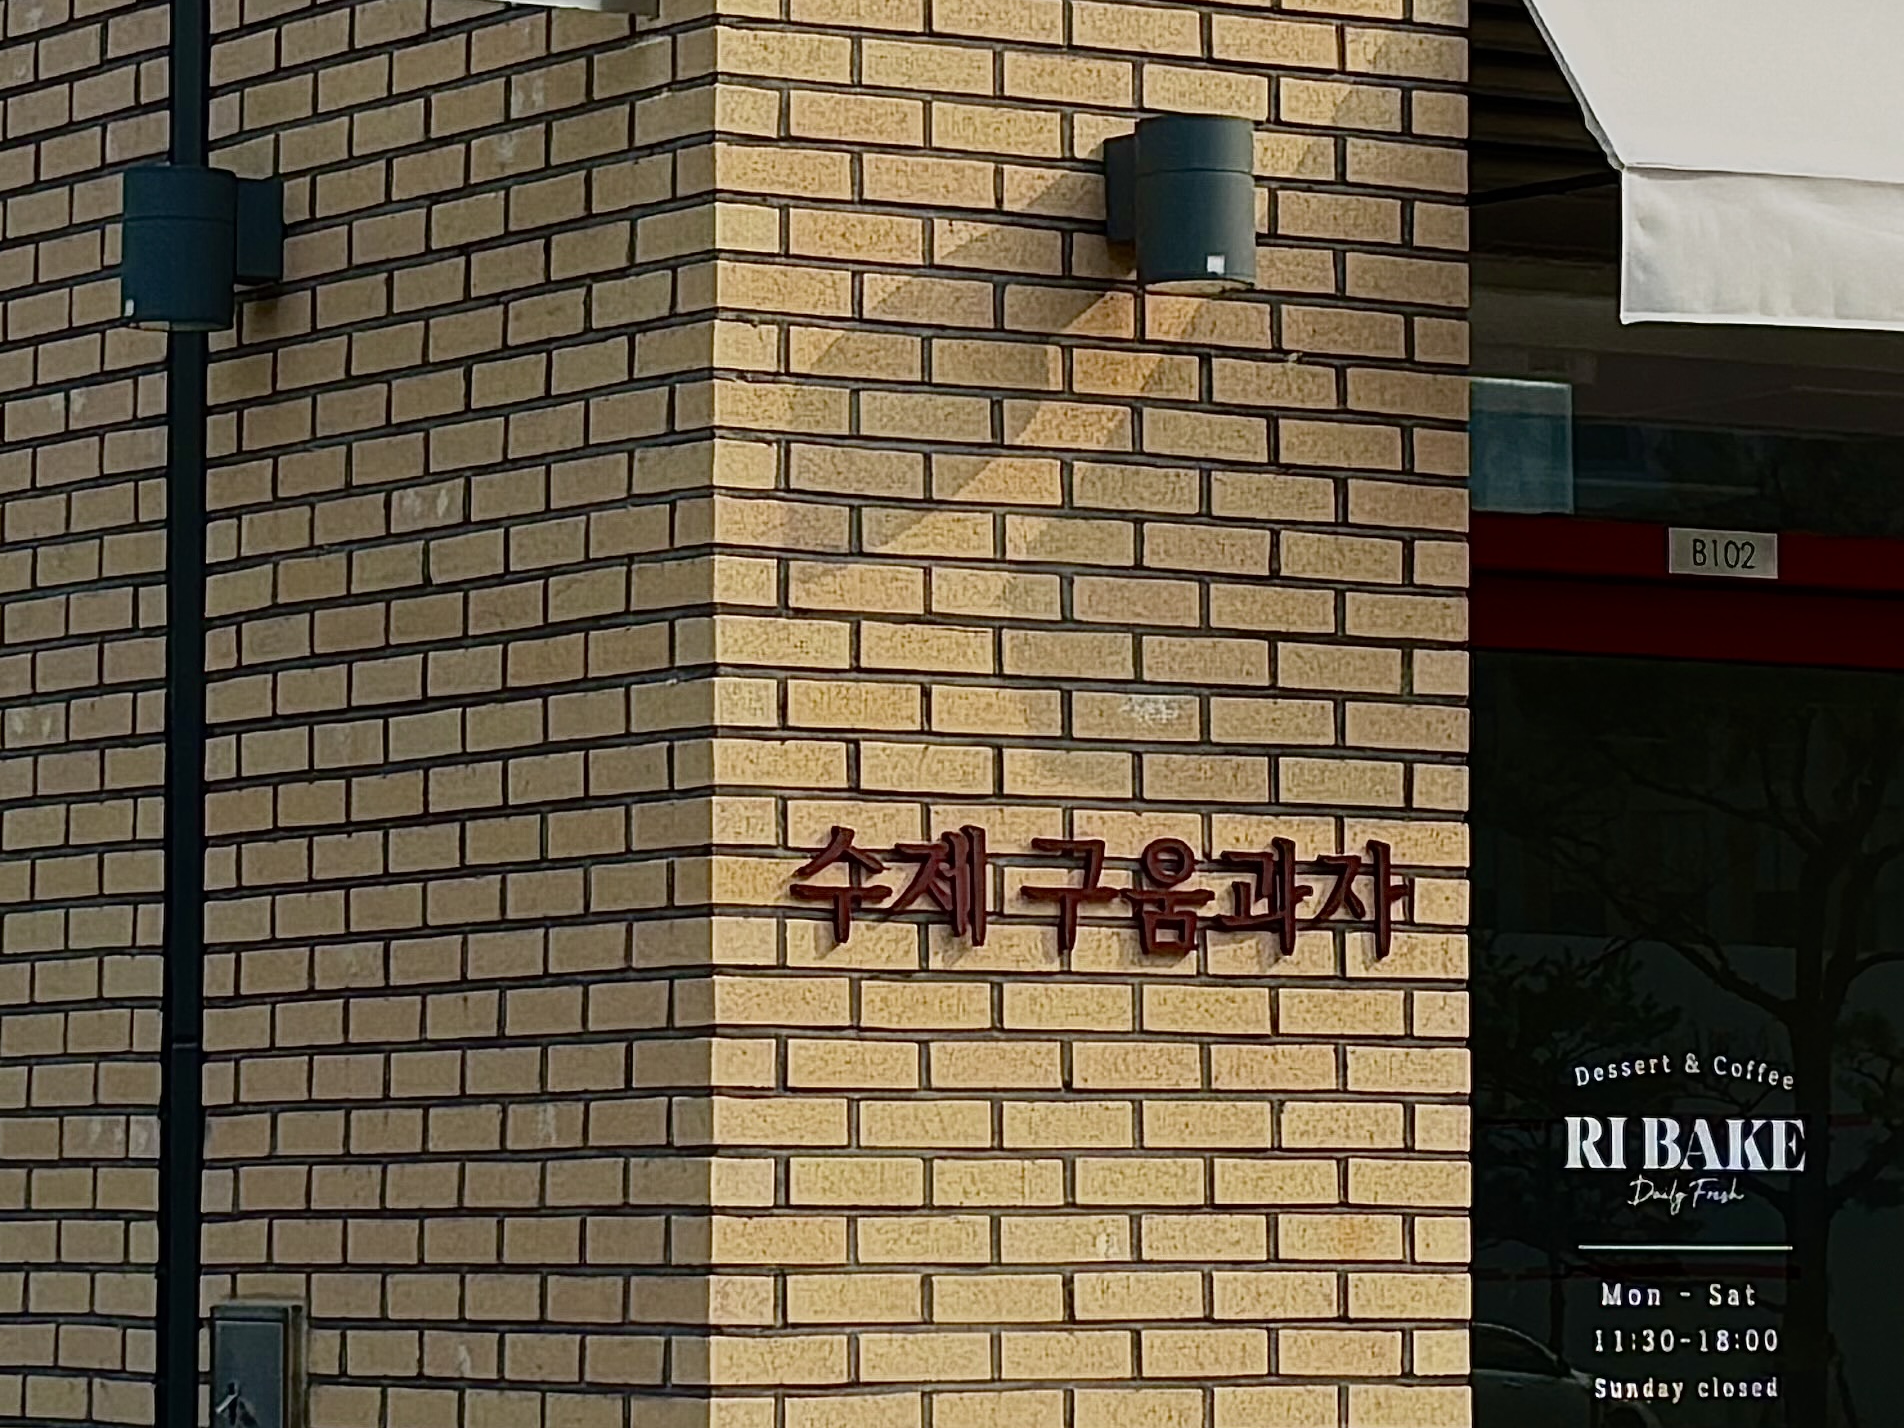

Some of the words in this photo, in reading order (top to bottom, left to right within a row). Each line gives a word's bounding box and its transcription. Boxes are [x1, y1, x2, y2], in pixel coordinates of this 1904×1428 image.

[1692, 539, 1756, 570] B102
[789, 825, 985, 947] 수제
[1020, 836, 1408, 959] 구움과자
[1574, 1054, 1671, 1087] Dessert
[1684, 1052, 1701, 1074] &
[1713, 1055, 1794, 1090] Coffee
[1564, 1116, 1628, 1170] RI
[1641, 1117, 1806, 1172] BAKE
[1627, 1174, 1687, 1216] Daily
[1601, 1282, 1661, 1306] Mon
[1709, 1283, 1756, 1307] Sat
[1595, 1328, 1778, 1353] 11:30-18:00
[1594, 1377, 1684, 1404] Sunday
[1697, 1376, 1778, 1398] closed
